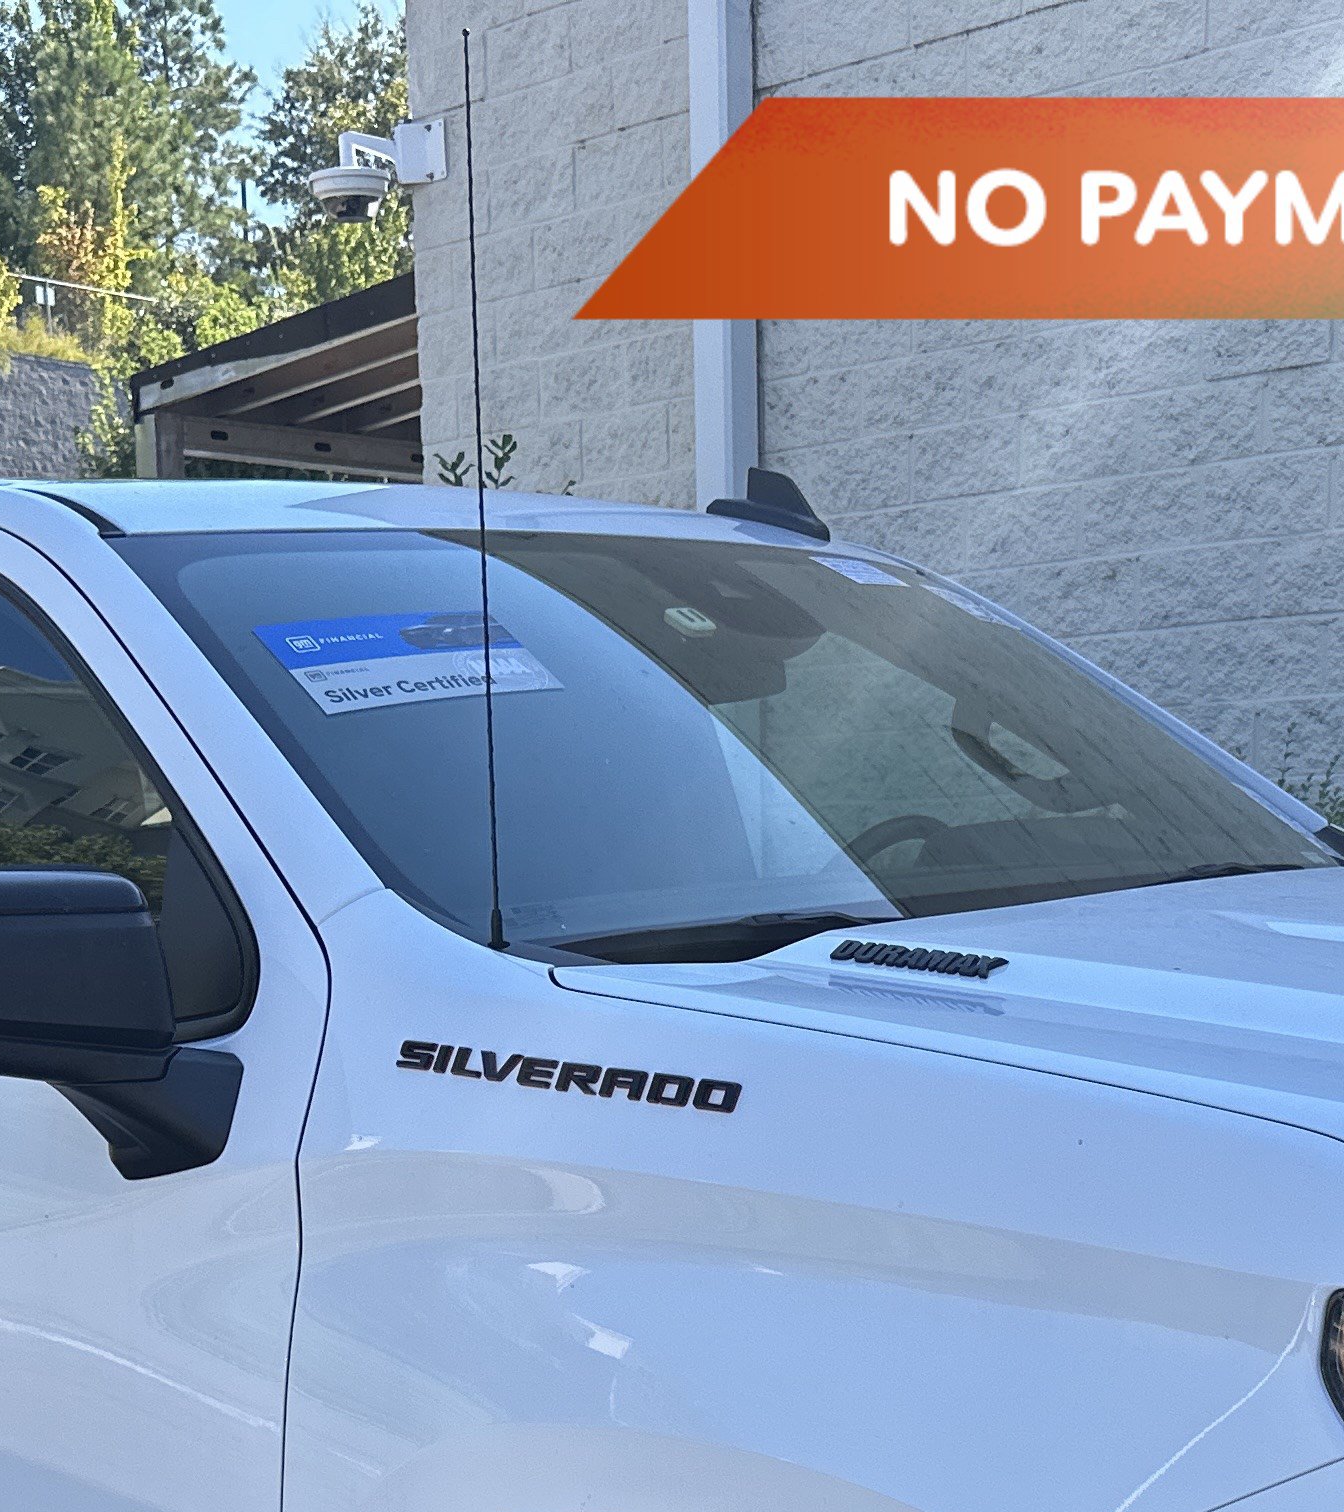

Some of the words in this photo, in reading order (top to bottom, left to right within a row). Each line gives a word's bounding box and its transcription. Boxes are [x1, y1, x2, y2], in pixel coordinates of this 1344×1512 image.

[318, 632, 384, 645] FINANCIAL
[324, 684, 393, 704] Silver
[829, 939, 1009, 980] DURAMAX
[396, 1039, 743, 1114] SILVERADO
